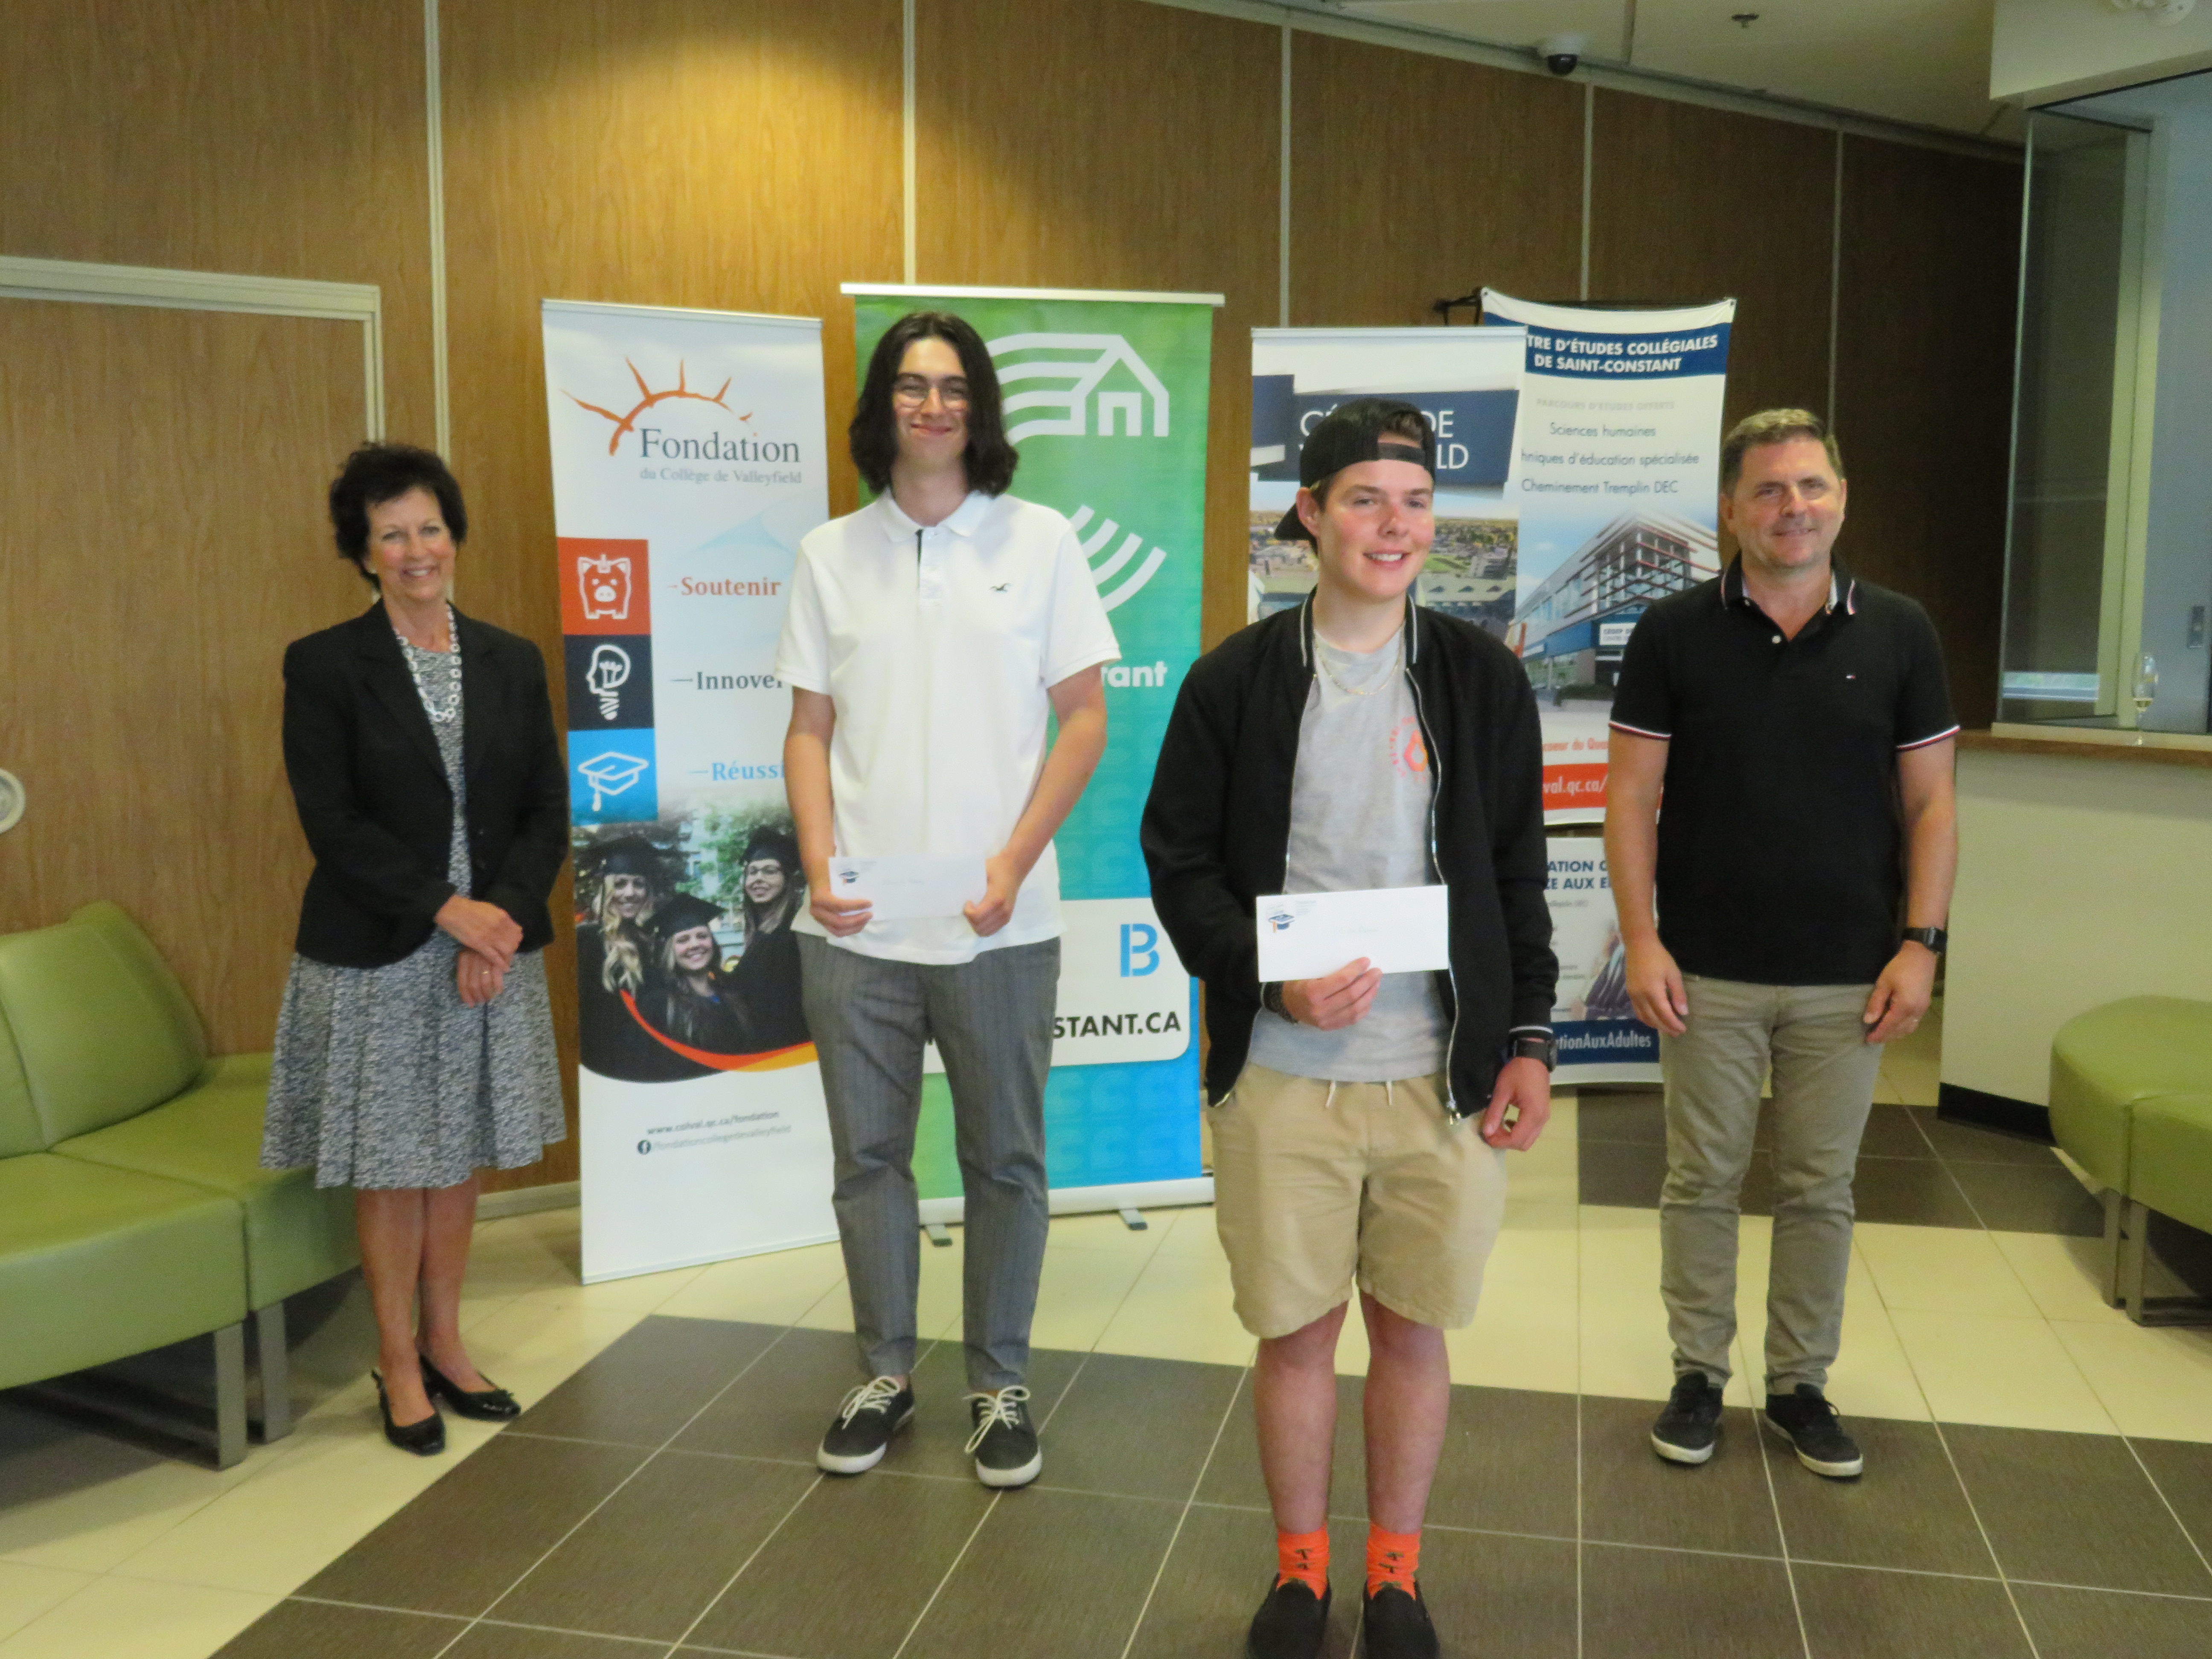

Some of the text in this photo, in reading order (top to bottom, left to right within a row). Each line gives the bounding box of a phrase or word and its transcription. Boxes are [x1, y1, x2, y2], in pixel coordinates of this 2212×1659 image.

[1627, 334, 1718, 355] COLLÉGIALES
[1534, 353, 1682, 373] DE SAINT-CONSTANT
[1549, 421, 1656, 437] Sciences humaines
[640, 428, 801, 463] Fondation
[1567, 451, 1635, 466] d'éducation
[1639, 451, 1700, 468] spécialisée
[640, 468, 802, 486] du Collège de Valleyfield
[1521, 478, 1679, 497] Cheminement Tremplin DEC
[681, 576, 782, 596] Soutenir
[1563, 877, 1595, 890] AUX
[1120, 923, 1160, 978] B
